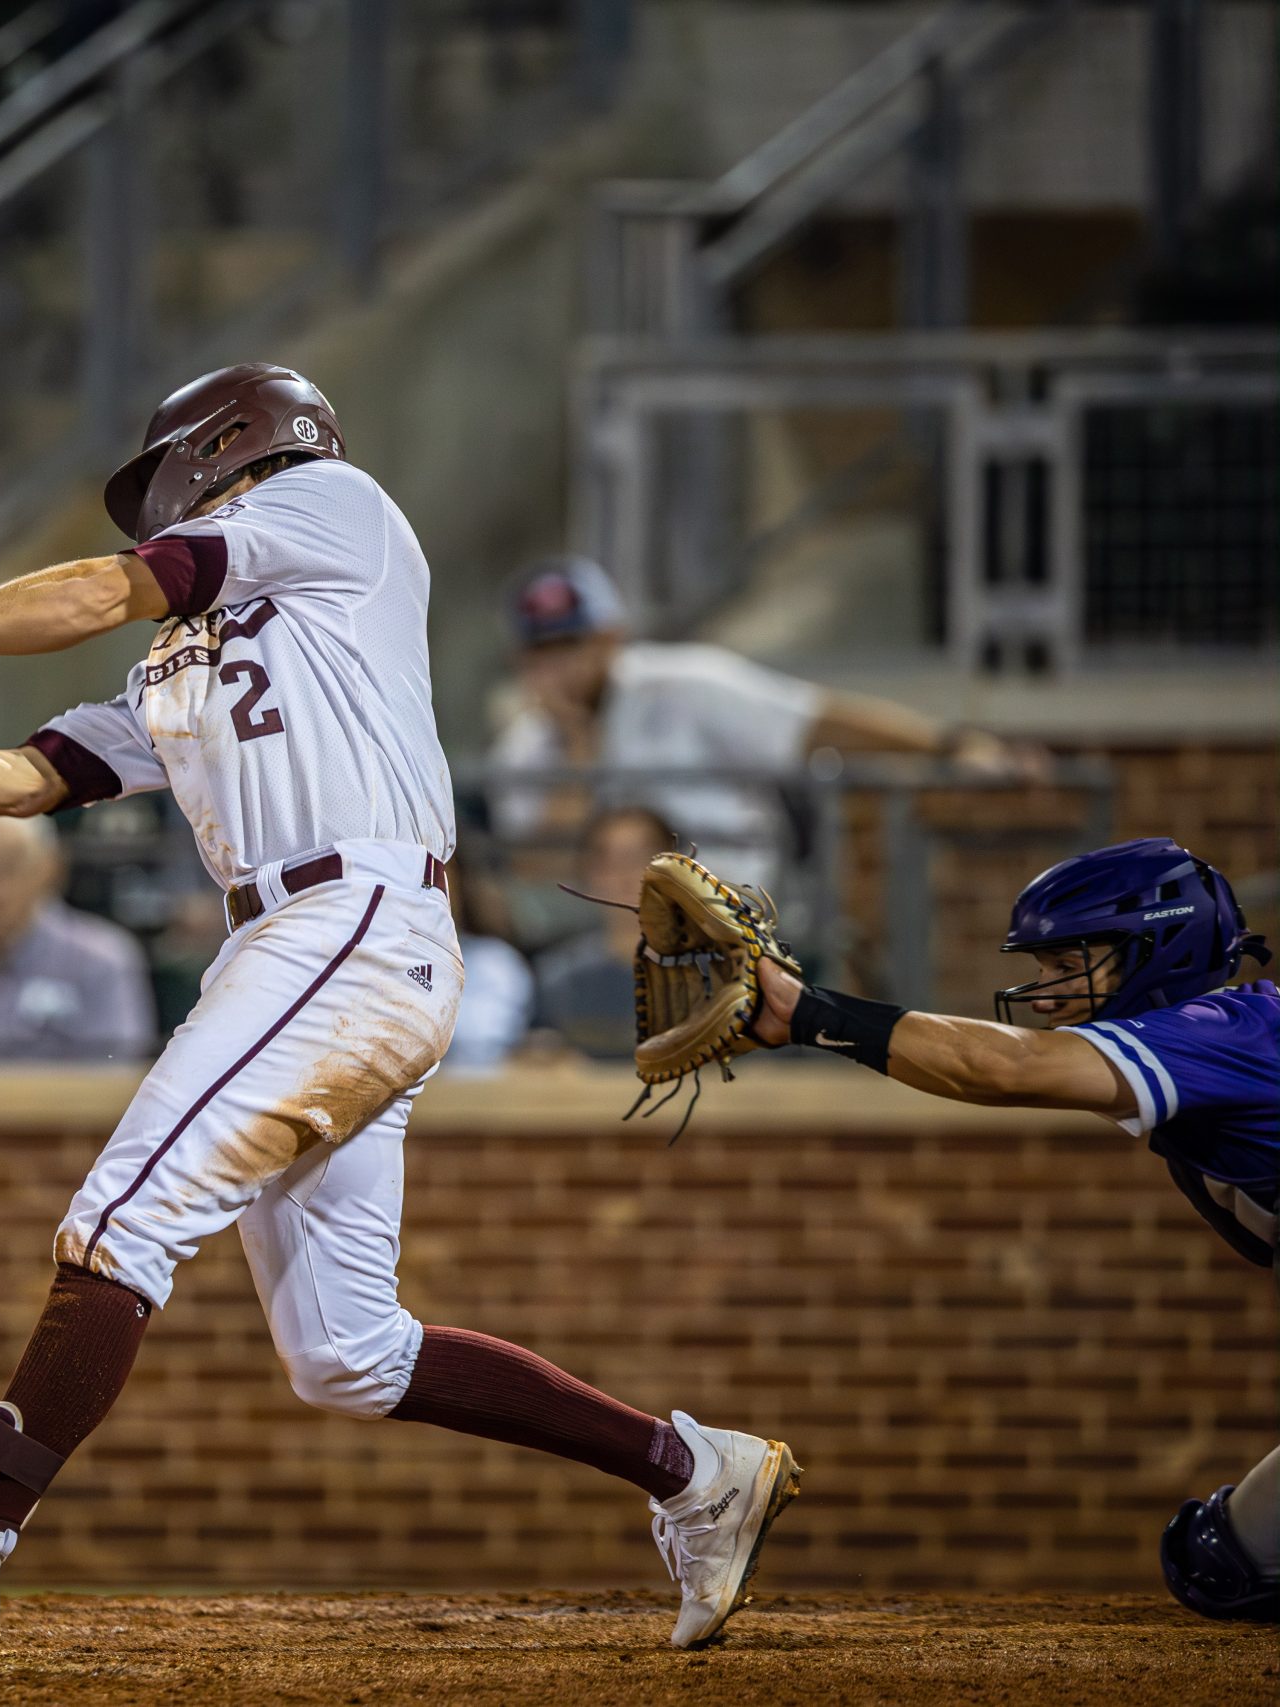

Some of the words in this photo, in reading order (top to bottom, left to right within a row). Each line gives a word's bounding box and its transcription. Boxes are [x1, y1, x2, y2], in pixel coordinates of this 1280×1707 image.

[296, 419, 316, 441] SEC
[218, 660, 285, 743] 2
[1143, 906, 1195, 921] EASTON
[407, 968, 433, 993] adidas
[709, 1487, 738, 1519] Aggies
